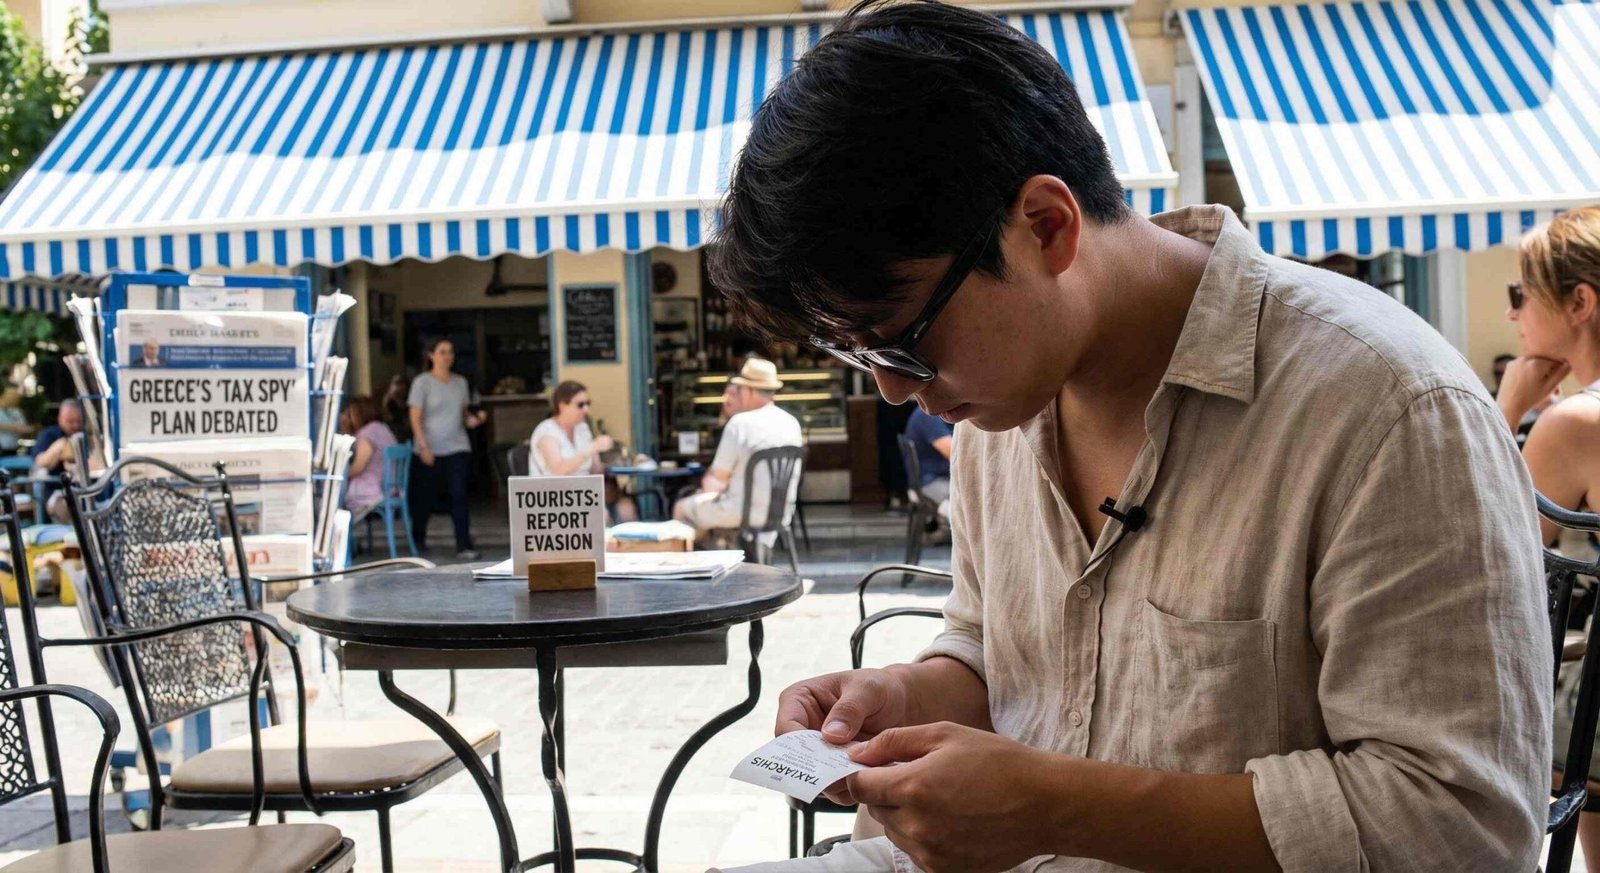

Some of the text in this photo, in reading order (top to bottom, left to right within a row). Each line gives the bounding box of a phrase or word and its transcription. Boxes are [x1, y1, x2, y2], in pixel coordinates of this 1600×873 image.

[130, 379, 212, 403] GREECE'S
[150, 411, 278, 435] PLAN DEBATED
[515, 489, 600, 509] TOURISTS:
[527, 511, 590, 530] REPORT
[524, 533, 593, 552] EVASION
[750, 756, 820, 786] TAXIARCHIS
